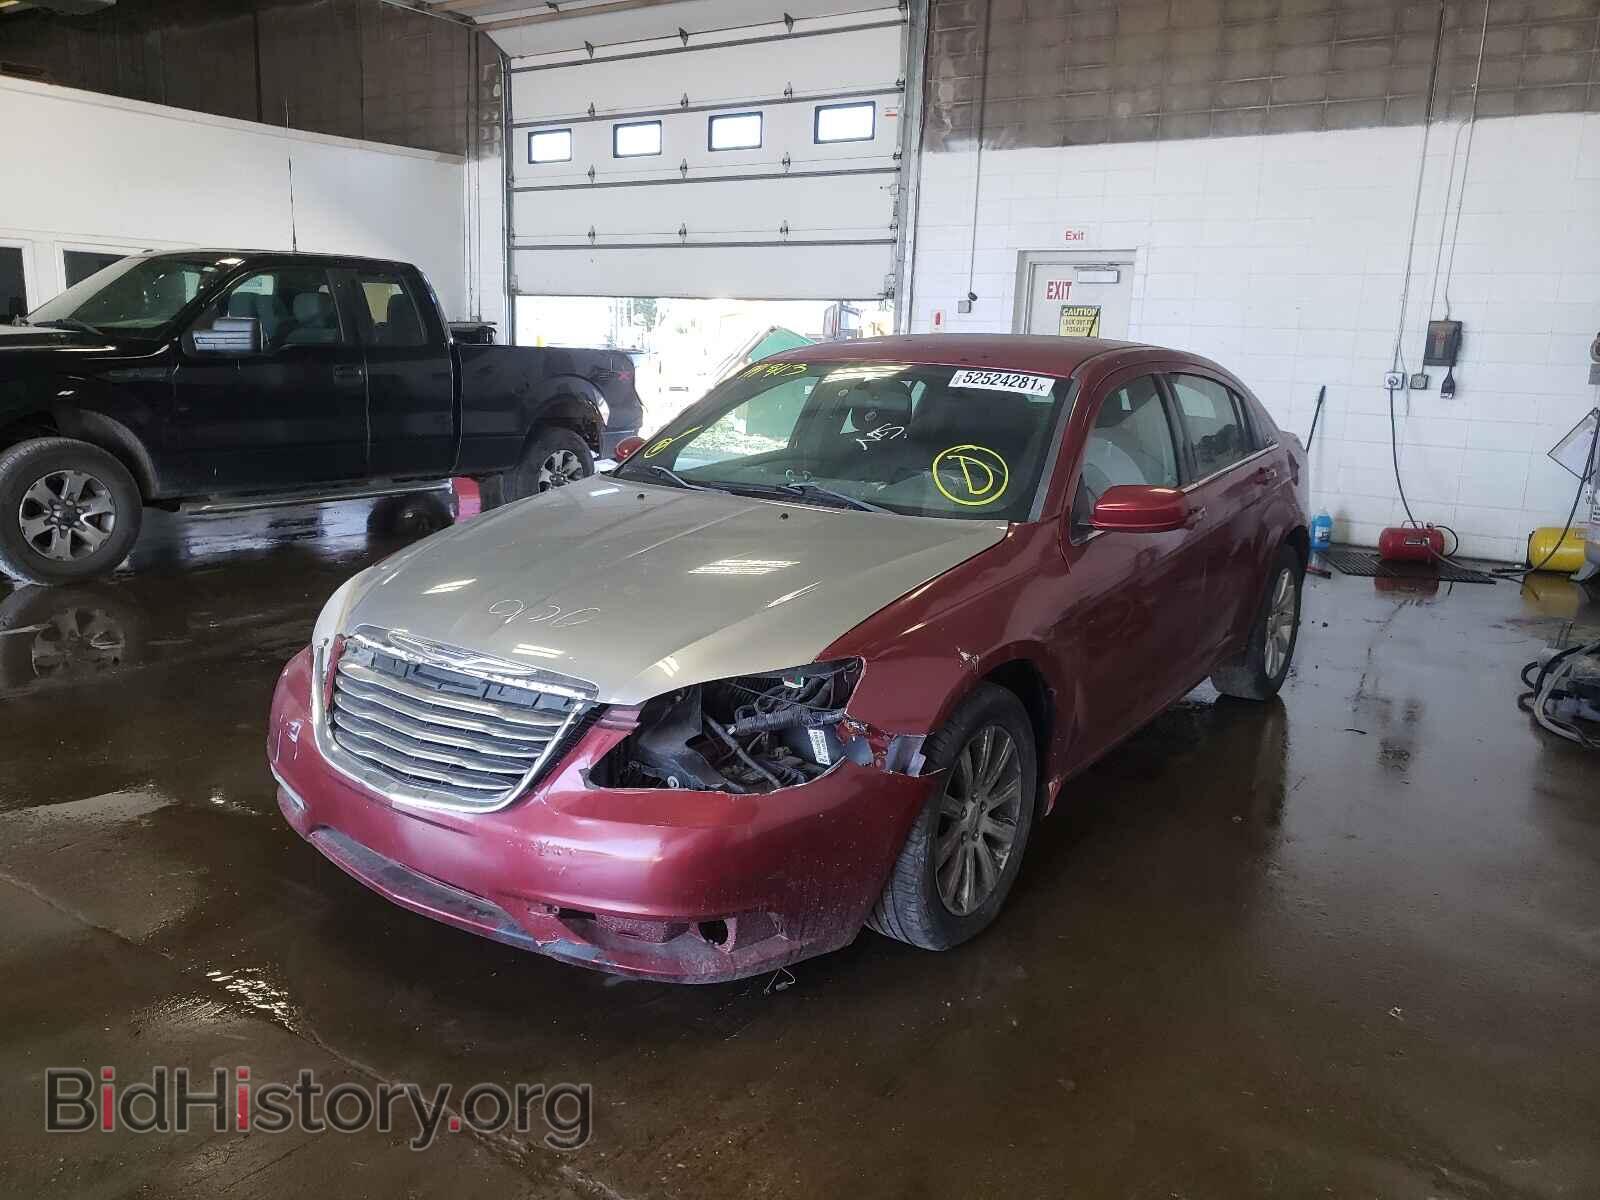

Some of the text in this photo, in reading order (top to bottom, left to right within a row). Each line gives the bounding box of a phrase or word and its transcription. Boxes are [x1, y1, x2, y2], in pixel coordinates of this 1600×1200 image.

[1065, 230, 1084, 240] Exit
[1046, 281, 1072, 300] EXIT
[1062, 307, 1098, 316] CAUTION
[962, 371, 1038, 391] 52524281
[946, 455, 994, 495] D
